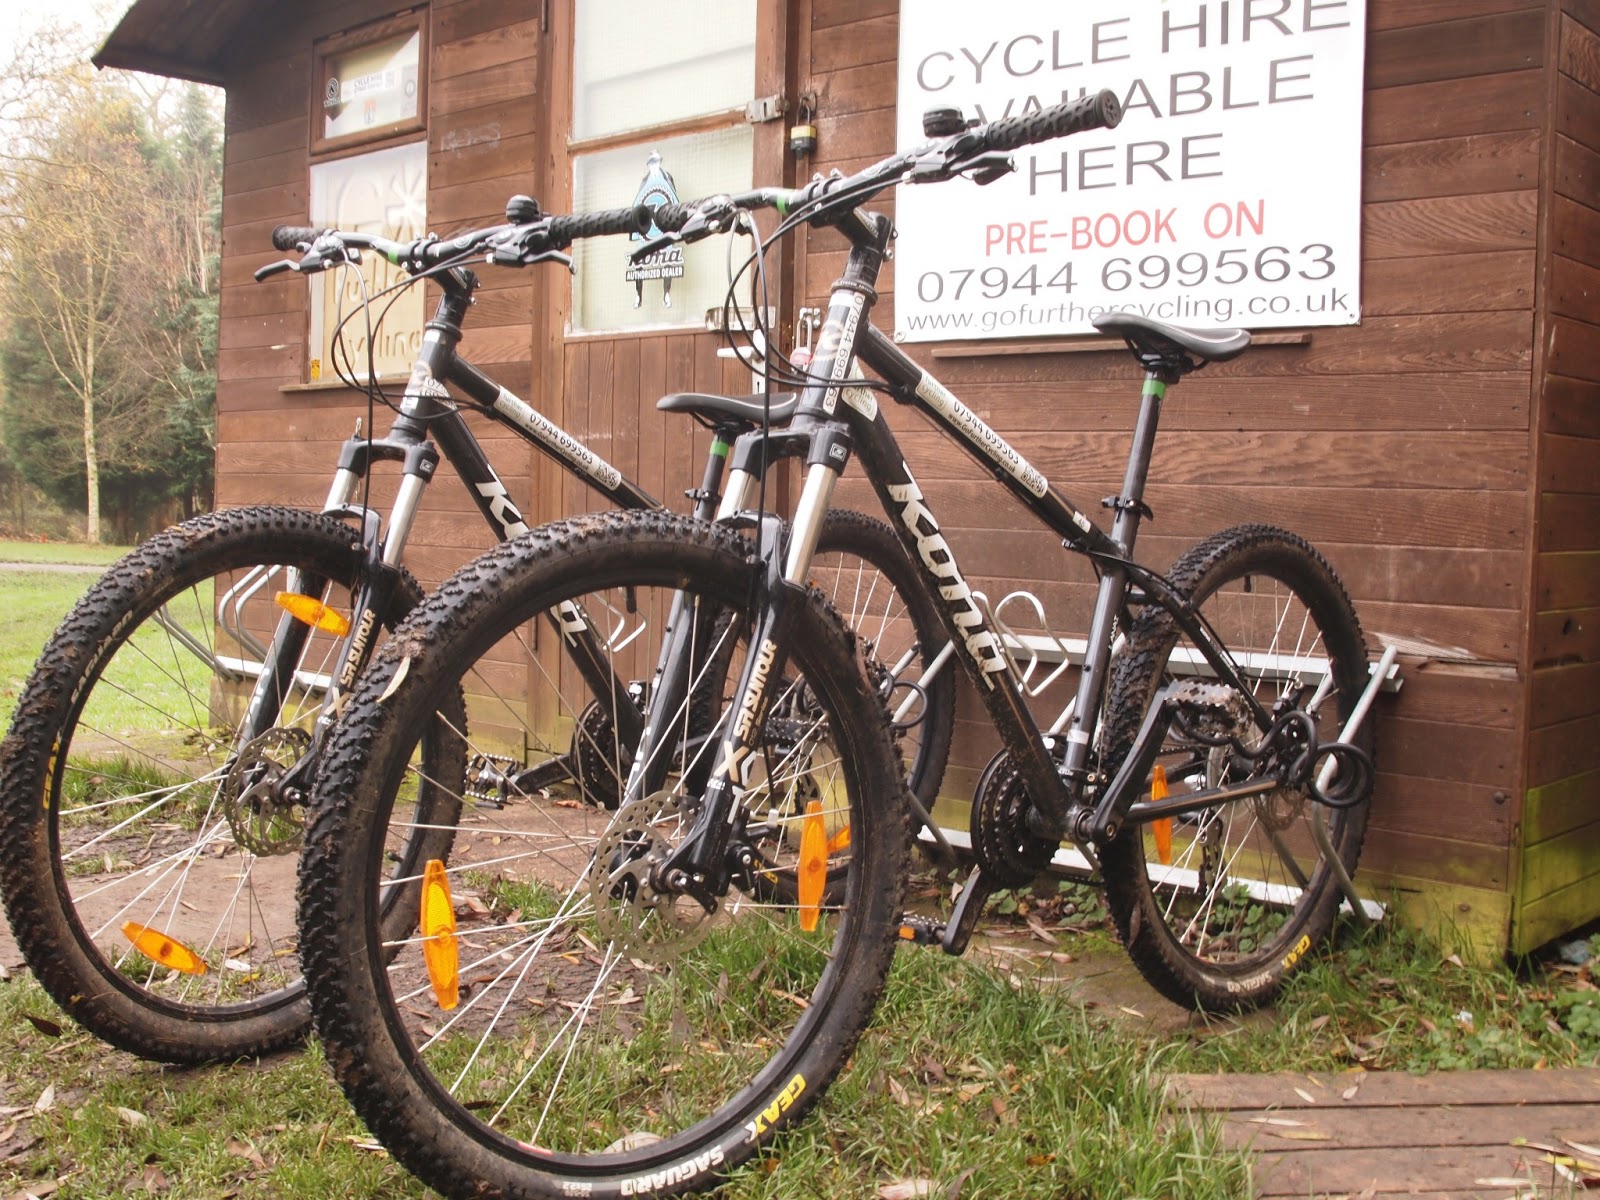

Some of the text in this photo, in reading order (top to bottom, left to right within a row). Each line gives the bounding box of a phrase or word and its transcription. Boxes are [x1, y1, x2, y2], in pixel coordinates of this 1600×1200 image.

[916, 0, 1351, 92] CYCLE HIRE
[974, 54, 1314, 125] VABLE
[1029, 132, 1223, 196] HERE
[985, 199, 1265, 257] PRE-BOOK ON
[627, 266, 683, 280] AUTHORIZED DEALER
[917, 243, 1336, 303] 07944 699563
[844, 294, 865, 343] 07944
[825, 347, 849, 408] 69963
[529, 412, 593, 465] 07944 699563
[948, 412, 1016, 474] www.GoFurtherCycling.co.uk
[953, 400, 1019, 465] 07944 699563
[348, 608, 376, 665] SUNTOUR
[743, 638, 777, 712] SUNTOUR
[744, 1073, 807, 1144] GEAX
